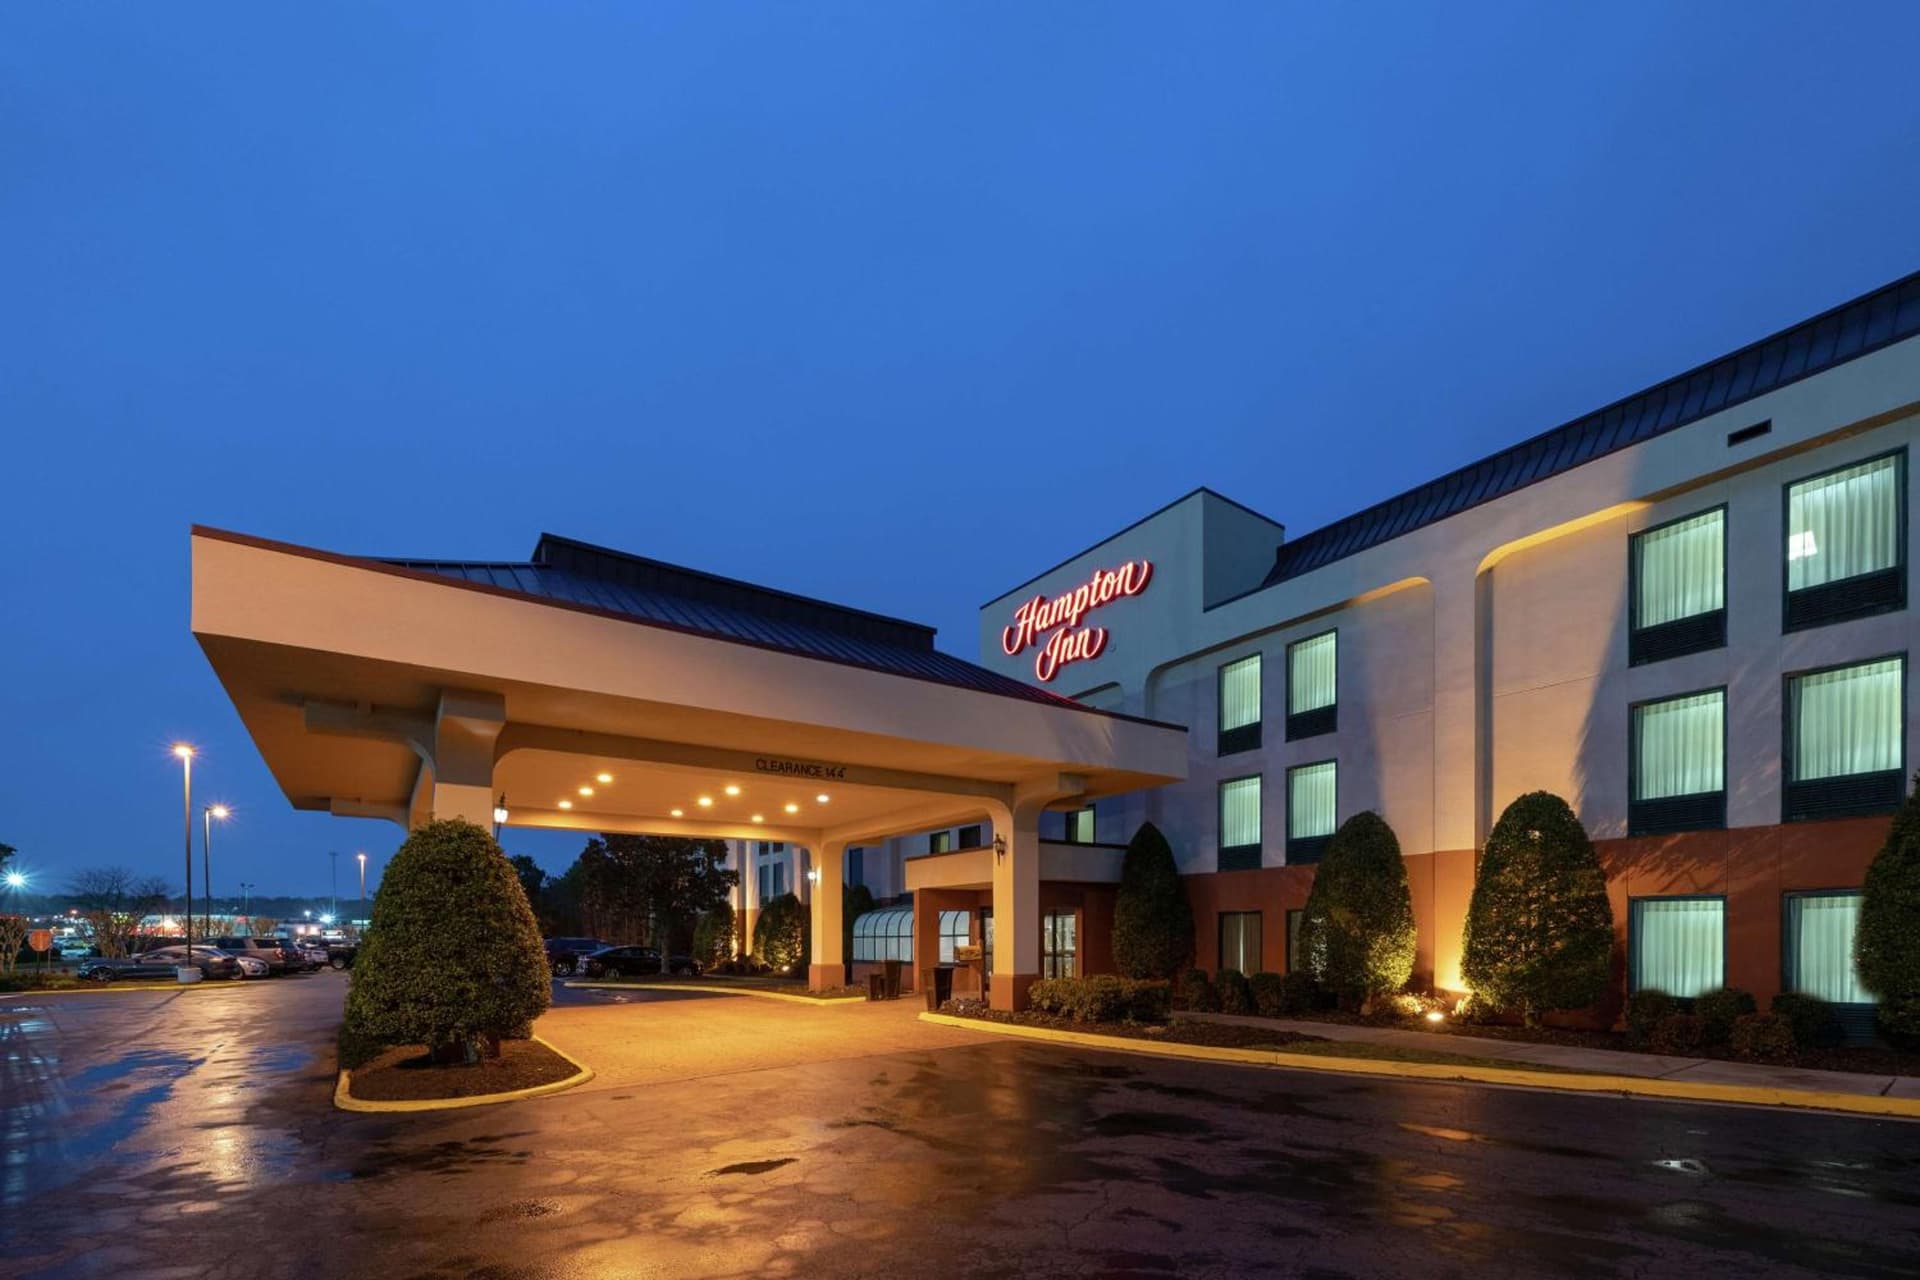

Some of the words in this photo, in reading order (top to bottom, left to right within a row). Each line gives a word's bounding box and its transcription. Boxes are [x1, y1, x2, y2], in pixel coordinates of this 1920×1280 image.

[1003, 560, 1153, 656] Hampton
[1036, 627, 1108, 682] Inn
[755, 758, 823, 777] CLEARANCE
